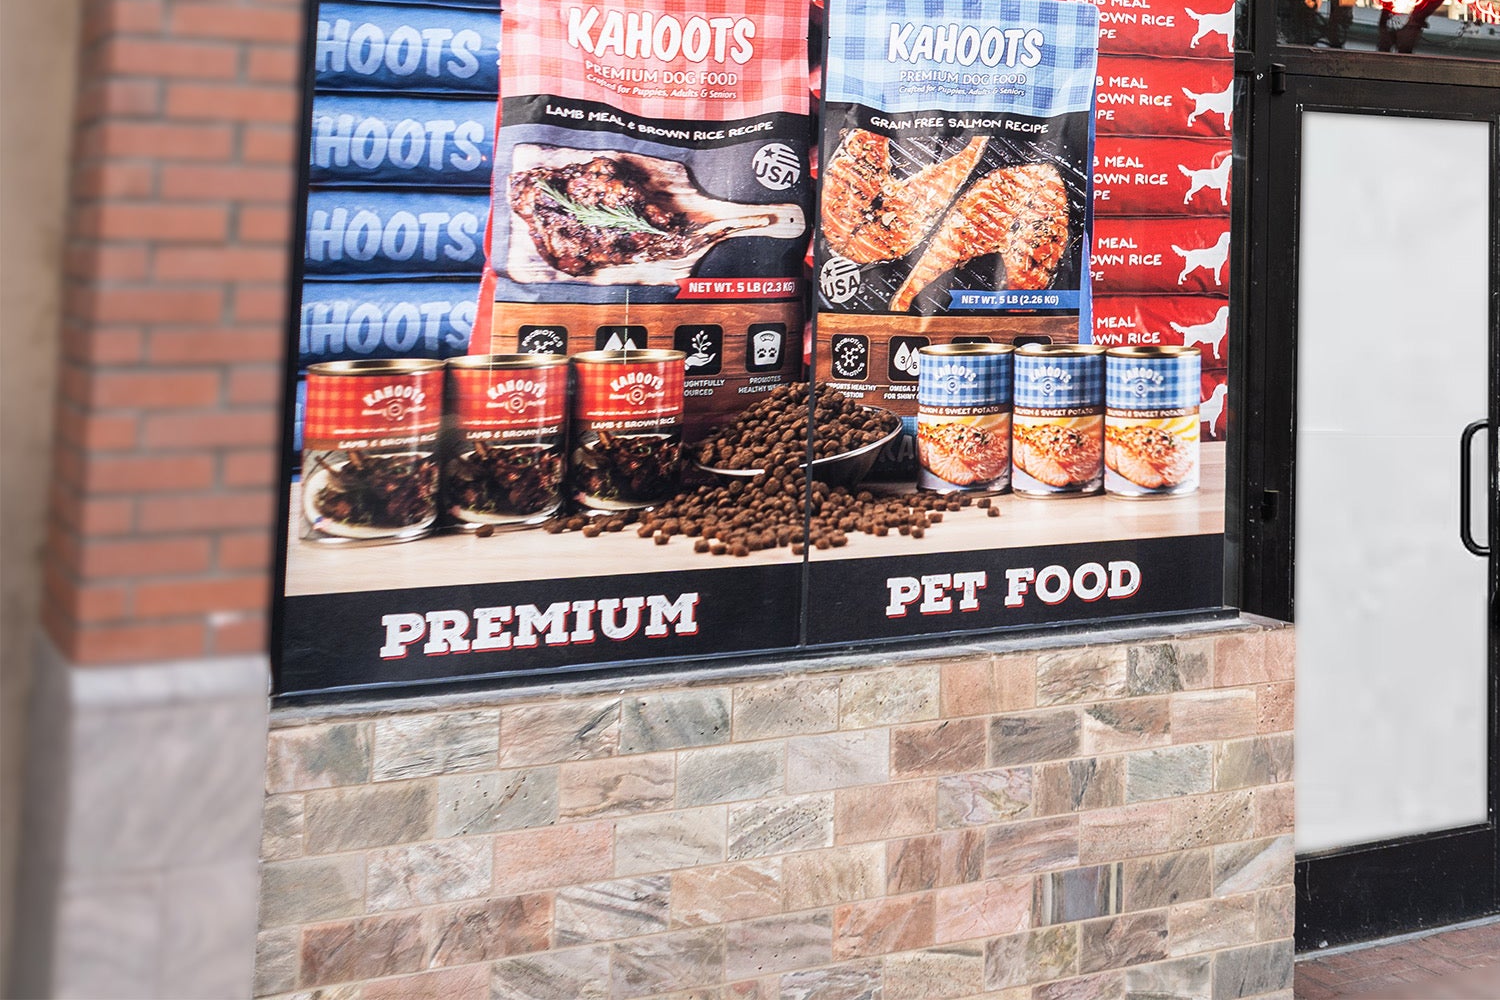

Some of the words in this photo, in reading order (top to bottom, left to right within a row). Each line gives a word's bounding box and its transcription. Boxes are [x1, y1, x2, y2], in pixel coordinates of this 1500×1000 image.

[1100, 12, 1137, 25] OWN
[1141, 15, 1175, 27] RICE
[567, 6, 756, 65] KAHOOTS
[316, 18, 482, 79] HOOTS
[888, 22, 1045, 69] KAHOOTS
[585, 60, 658, 84] PREMIUM
[663, 72, 697, 86] DOG
[700, 72, 738, 86] FOOD
[899, 70, 960, 84] PREMIUM
[963, 74, 990, 86] DOG
[993, 74, 1028, 85] FOOD
[1109, 76, 1148, 89] MEAL
[617, 84, 630, 95] for
[632, 87, 669, 98] Puppies,
[709, 89, 738, 99] Seniors
[1097, 93, 1135, 105] OWN
[1139, 94, 1172, 106] RICE
[546, 104, 585, 121] LAMB
[588, 111, 626, 128] MEAL
[638, 123, 691, 141] BROWN
[693, 130, 725, 141] RICE
[728, 121, 775, 138] RECIPE
[870, 116, 911, 130] GRAIN
[914, 117, 944, 129] FREE
[949, 117, 1002, 129] SALMON
[1005, 120, 1049, 134] RECIPE
[310, 113, 485, 172] HOOTS
[1104, 156, 1144, 168] MEAL
[754, 160, 794, 186] USA
[1093, 173, 1130, 185] OWN
[1135, 174, 1168, 185] RICE
[305, 207, 478, 262] HOOTS
[1098, 238, 1138, 249] MEAL
[1090, 255, 1124, 265] OWN
[1128, 254, 1162, 266] RICE
[689, 282, 712, 293] NET
[714, 283, 735, 293] WT.
[737, 283, 745, 293] 5
[747, 283, 761, 293] LB
[762, 283, 781, 295] (2.3
[783, 282, 795, 293] KG)
[823, 275, 859, 299] USA
[961, 295, 980, 304] NET
[981, 296, 998, 305] WT.
[999, 295, 1005, 304] 5
[1006, 295, 1018, 304] LB
[1020, 295, 1043, 306] (2.26
[1044, 295, 1059, 305] KG)
[299, 300, 476, 355] HOOTS
[1097, 316, 1136, 328] MEAL
[1127, 332, 1161, 343] RICE
[900, 355, 906, 364] 3
[912, 361, 918, 370] 6
[487, 379, 546, 400] KAHOOTS
[609, 372, 664, 392] KAHOOTS
[683, 379, 725, 388] UGHTFULLY
[683, 388, 714, 397] OURCED
[379, 593, 700, 661] PREMIUM
[885, 571, 988, 619] PET
[1004, 560, 1143, 608] FOOD
